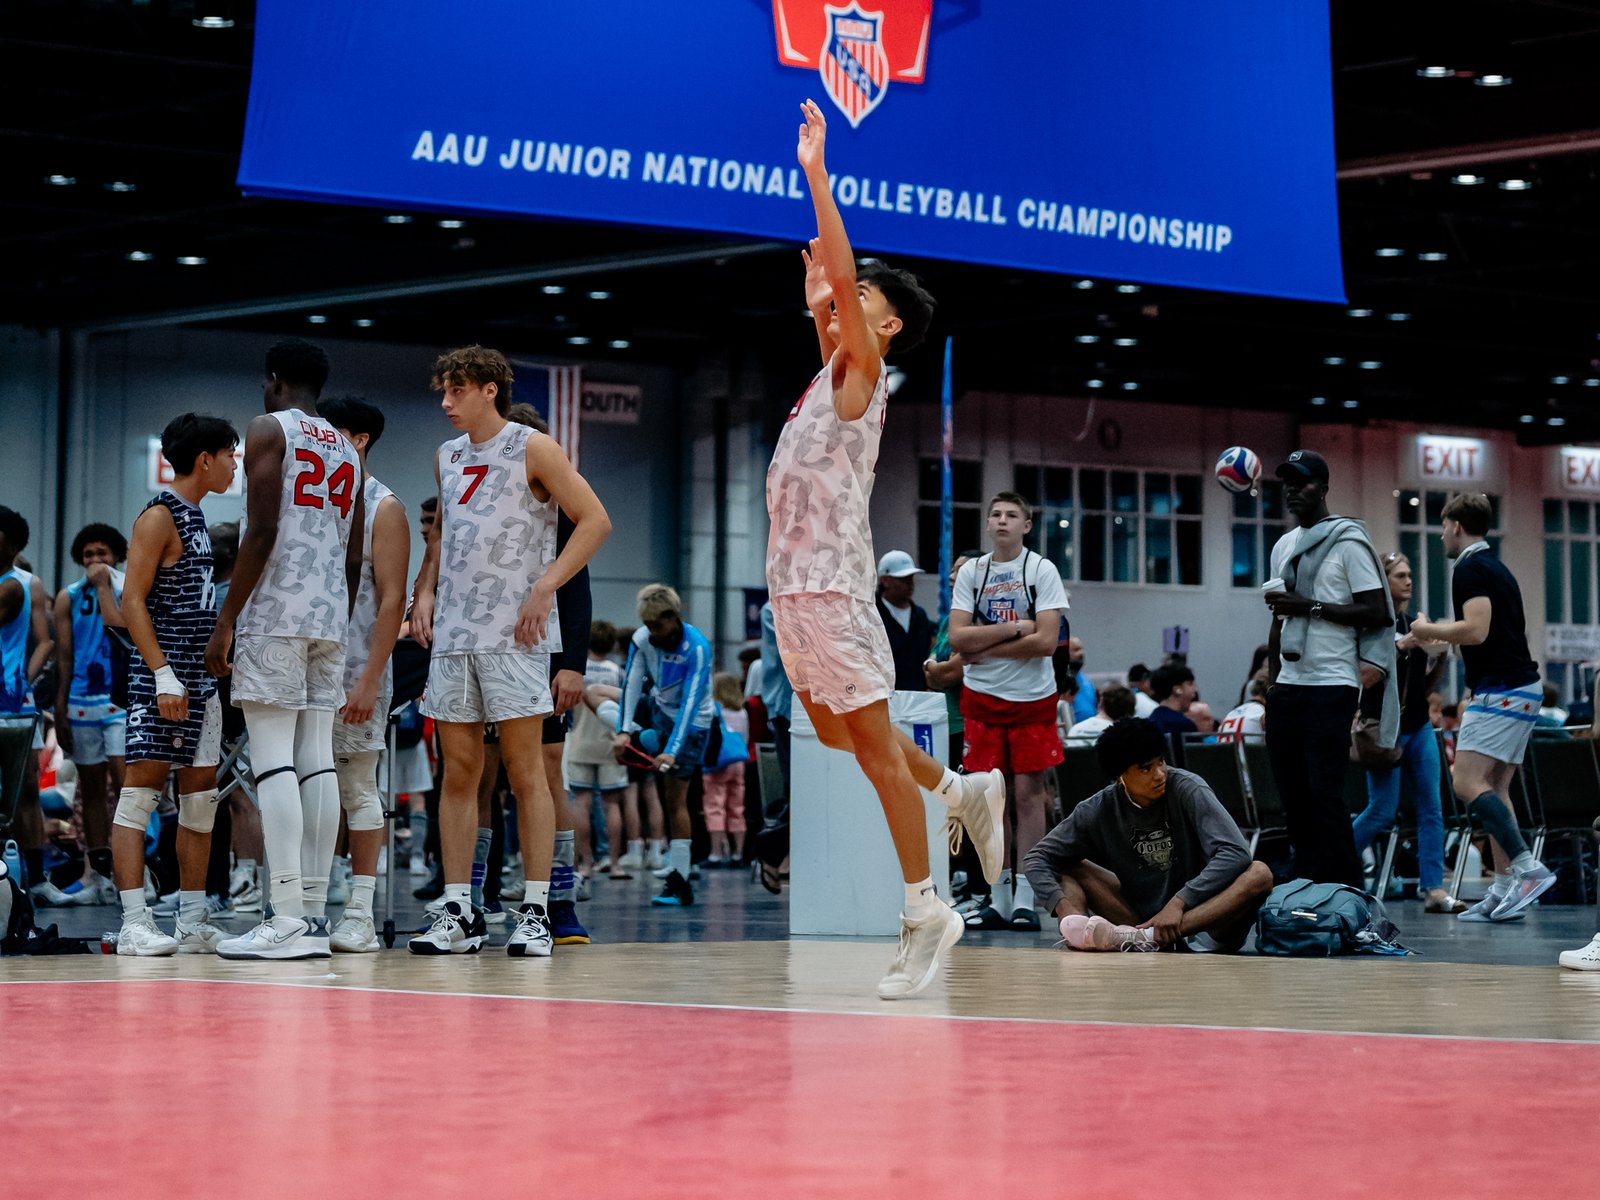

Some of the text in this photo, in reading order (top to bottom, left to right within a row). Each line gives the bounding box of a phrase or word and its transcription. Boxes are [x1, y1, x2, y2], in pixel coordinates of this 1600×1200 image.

[412, 130, 489, 167] AAU
[500, 138, 631, 180] JUNIOR
[642, 151, 805, 200] NATIONAL
[1017, 198, 1232, 253] CHAMPIONSHIP
[582, 391, 638, 412] OUTH
[1423, 445, 1480, 478] EXIT
[293, 447, 355, 520] 24
[457, 464, 489, 505] 7
